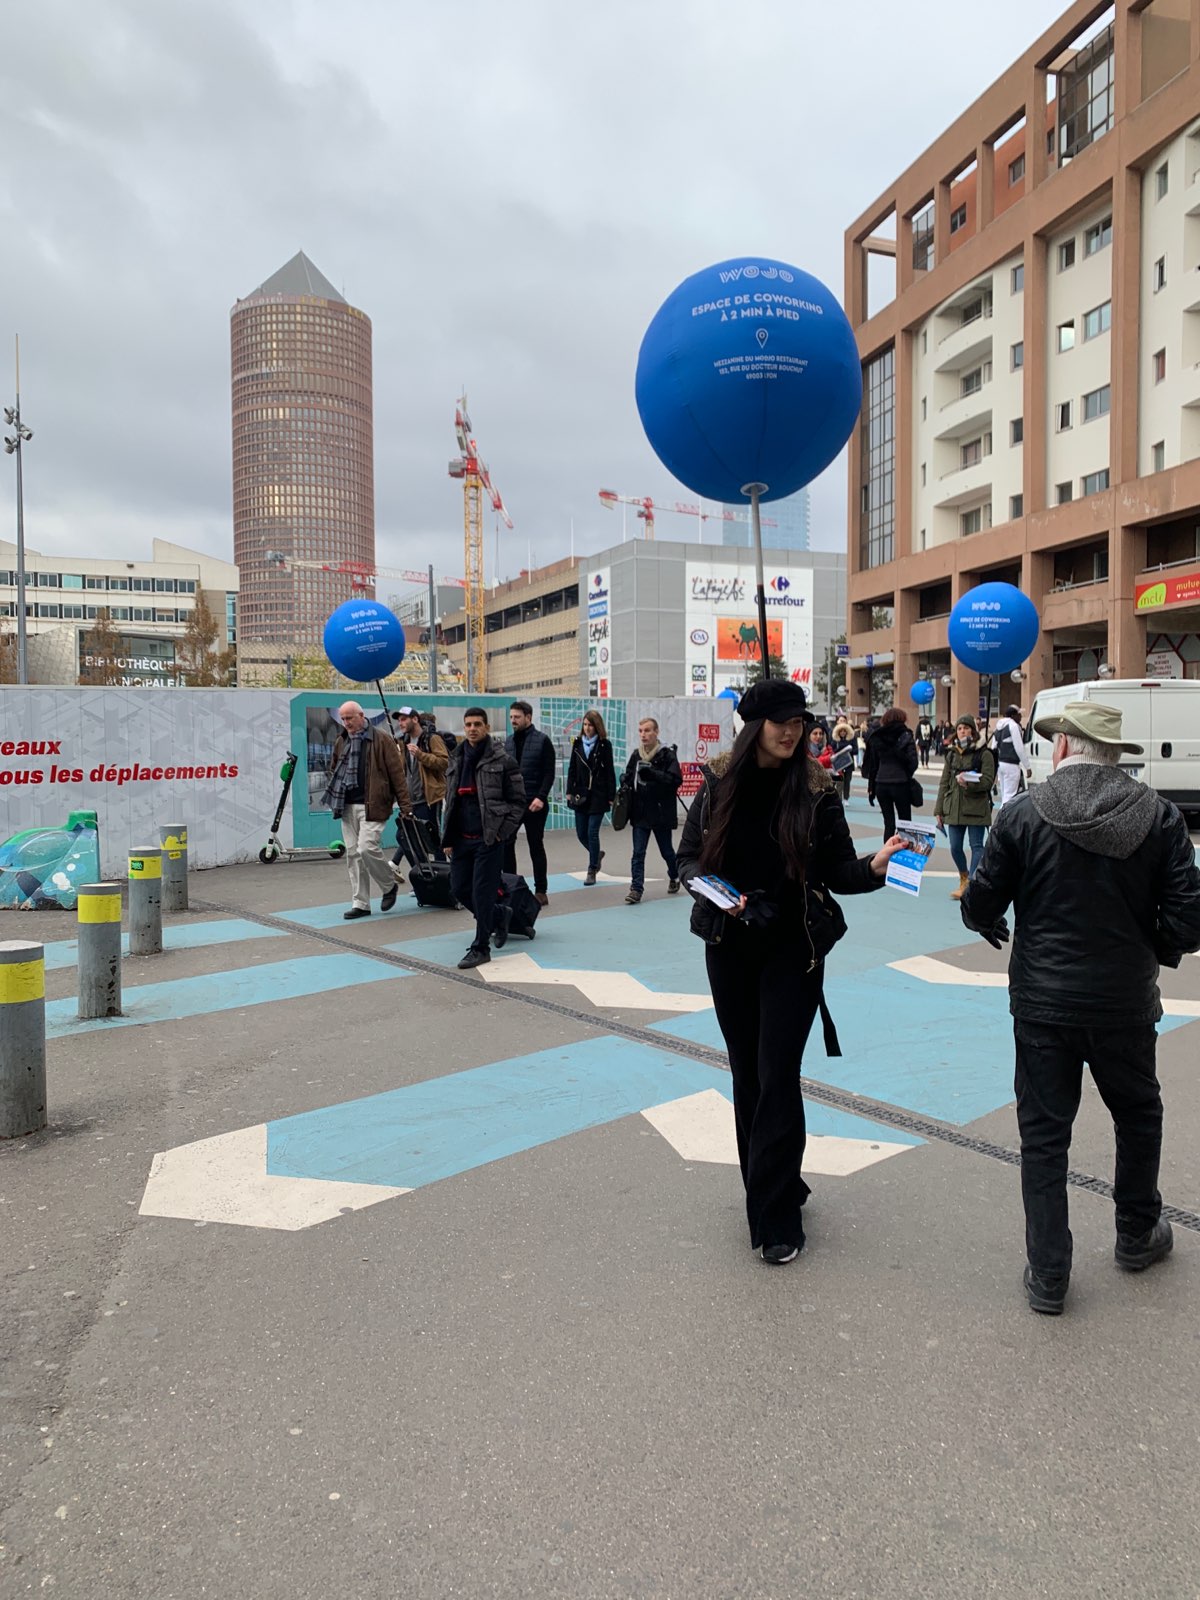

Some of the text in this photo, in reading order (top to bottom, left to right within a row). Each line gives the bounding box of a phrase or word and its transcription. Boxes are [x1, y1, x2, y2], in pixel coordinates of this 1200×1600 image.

[718, 265, 794, 284] WOJO
[692, 293, 824, 316] ESPACE DE COWORKING
[720, 304, 800, 322] À 2 MIN À PIED
[0, 741, 62, 756] eaux
[50, 765, 84, 783] les
[89, 763, 239, 786] déplacements
